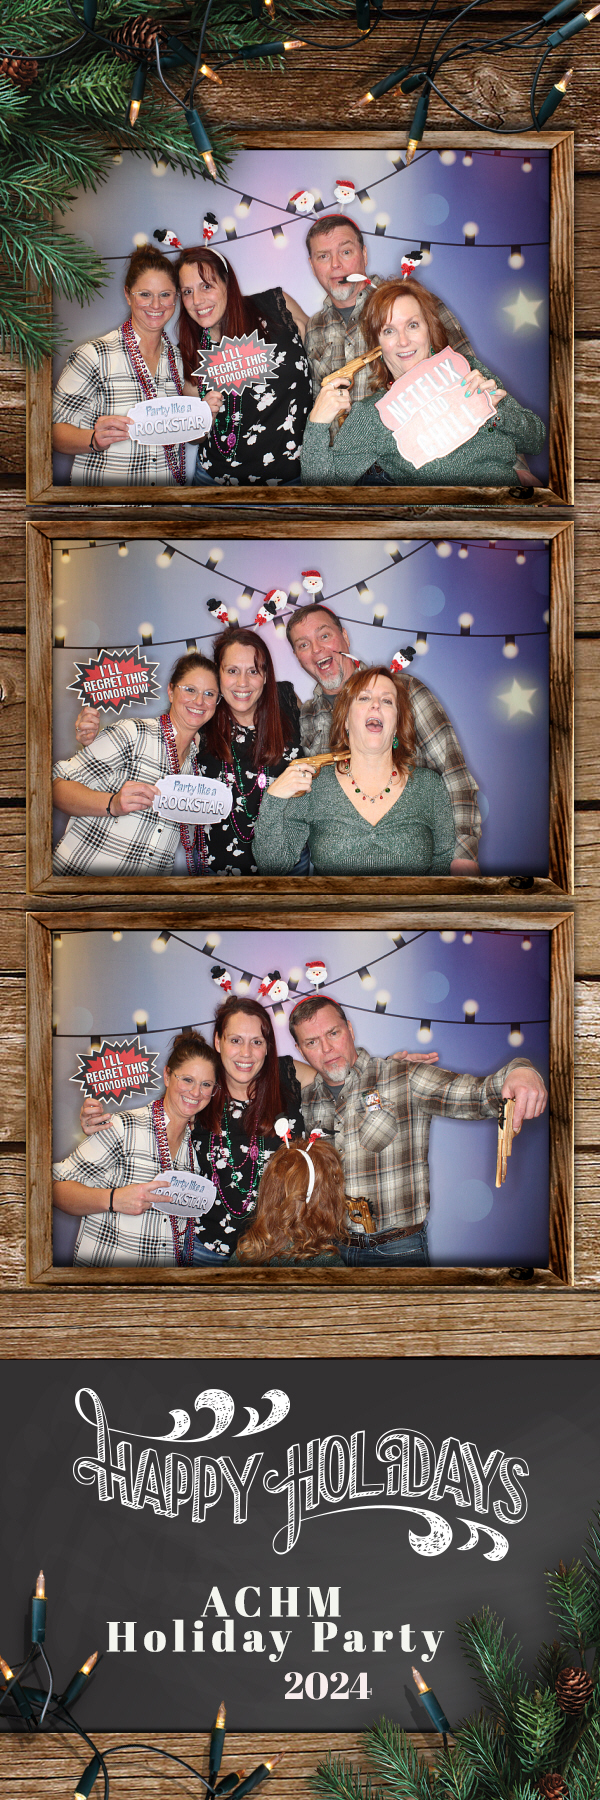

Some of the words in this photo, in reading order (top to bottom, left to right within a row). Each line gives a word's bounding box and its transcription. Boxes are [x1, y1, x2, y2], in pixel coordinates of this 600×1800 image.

[207, 358, 243, 377] REGRET
[246, 352, 268, 368] THIS
[221, 347, 243, 362] I'LL
[214, 364, 268, 386] TOMORROW
[386, 358, 463, 426] NETFLIX
[145, 405, 170, 418] Party
[170, 402, 185, 414] like
[420, 396, 451, 424] AND
[135, 415, 206, 437] ROCKSTAR
[416, 404, 482, 457] CHILL
[99, 662, 123, 678] I'LL
[83, 675, 124, 693] REGRET
[124, 671, 149, 685] THIS
[90, 683, 149, 703] TOMORROW
[173, 780, 197, 796] Party
[197, 783, 211, 796] like
[157, 795, 225, 816] ROCKSTAR
[101, 1053, 124, 1069] I'LL
[85, 1066, 124, 1084] REGRET
[124, 1061, 149, 1076] THIS
[92, 1073, 149, 1094] TOMORROW
[170, 1175, 190, 1191] Party
[188, 1179, 200, 1191] like
